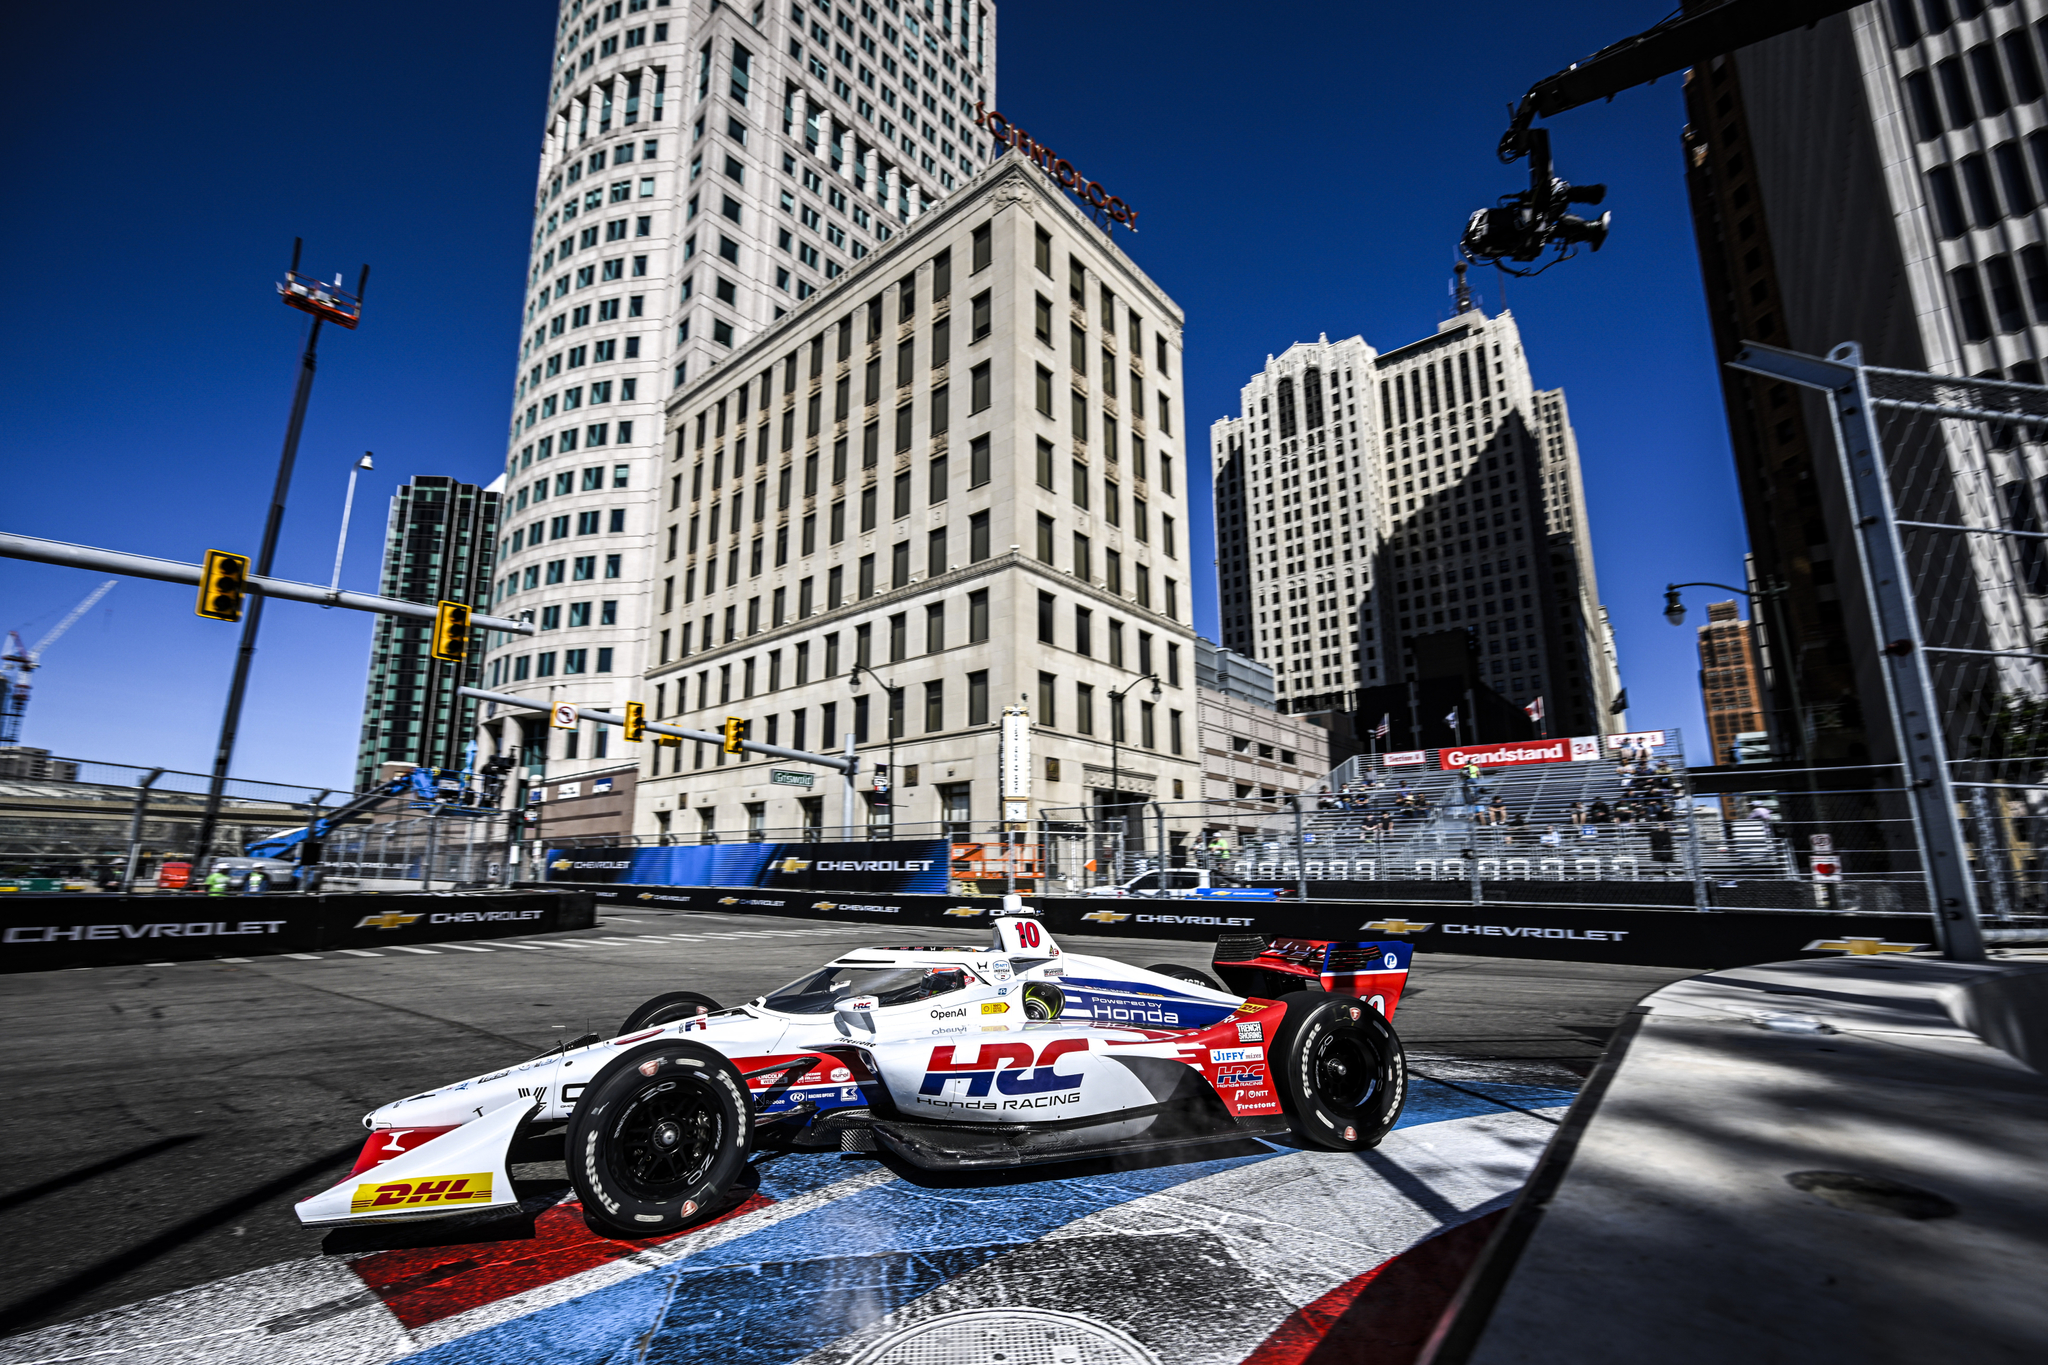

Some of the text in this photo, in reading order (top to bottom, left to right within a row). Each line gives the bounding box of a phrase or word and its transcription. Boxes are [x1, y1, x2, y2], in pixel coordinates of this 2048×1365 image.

[974, 101, 1140, 232] SCIENTOLOGY
[1447, 741, 1598, 765] Grandstand 3A
[774, 772, 812, 785] Griswold
[574, 860, 631, 870] CHEVROLET
[816, 859, 934, 872] CHEVROLET
[739, 898, 786, 907] CHEVROLET
[839, 903, 901, 913] CHEVROLET
[429, 910, 544, 924] CHEVROLET
[1136, 913, 1255, 927] CHEVROLET
[2, 920, 287, 943] CHEVROLET
[1014, 921, 1041, 949] 10
[1441, 923, 1629, 942] CHEVROLET
[853, 1002, 871, 1010] HRC
[1091, 996, 1162, 1009] Powered by
[930, 1008, 967, 1021] OpenAI
[1093, 1004, 1179, 1024] Honda
[1237, 1023, 1262, 1033] TRENCH
[1213, 1050, 1245, 1062] JIFFY
[1302, 1023, 1321, 1099] Firestone
[918, 1038, 1089, 1098] HRC
[1217, 1064, 1266, 1084] HRC
[1382, 1053, 1404, 1125] Firestone
[917, 1092, 1081, 1110] Honda RACING
[1236, 1102, 1276, 1111] Firestone
[586, 1130, 620, 1215] Firestone
[371, 1179, 475, 1207] DHL
